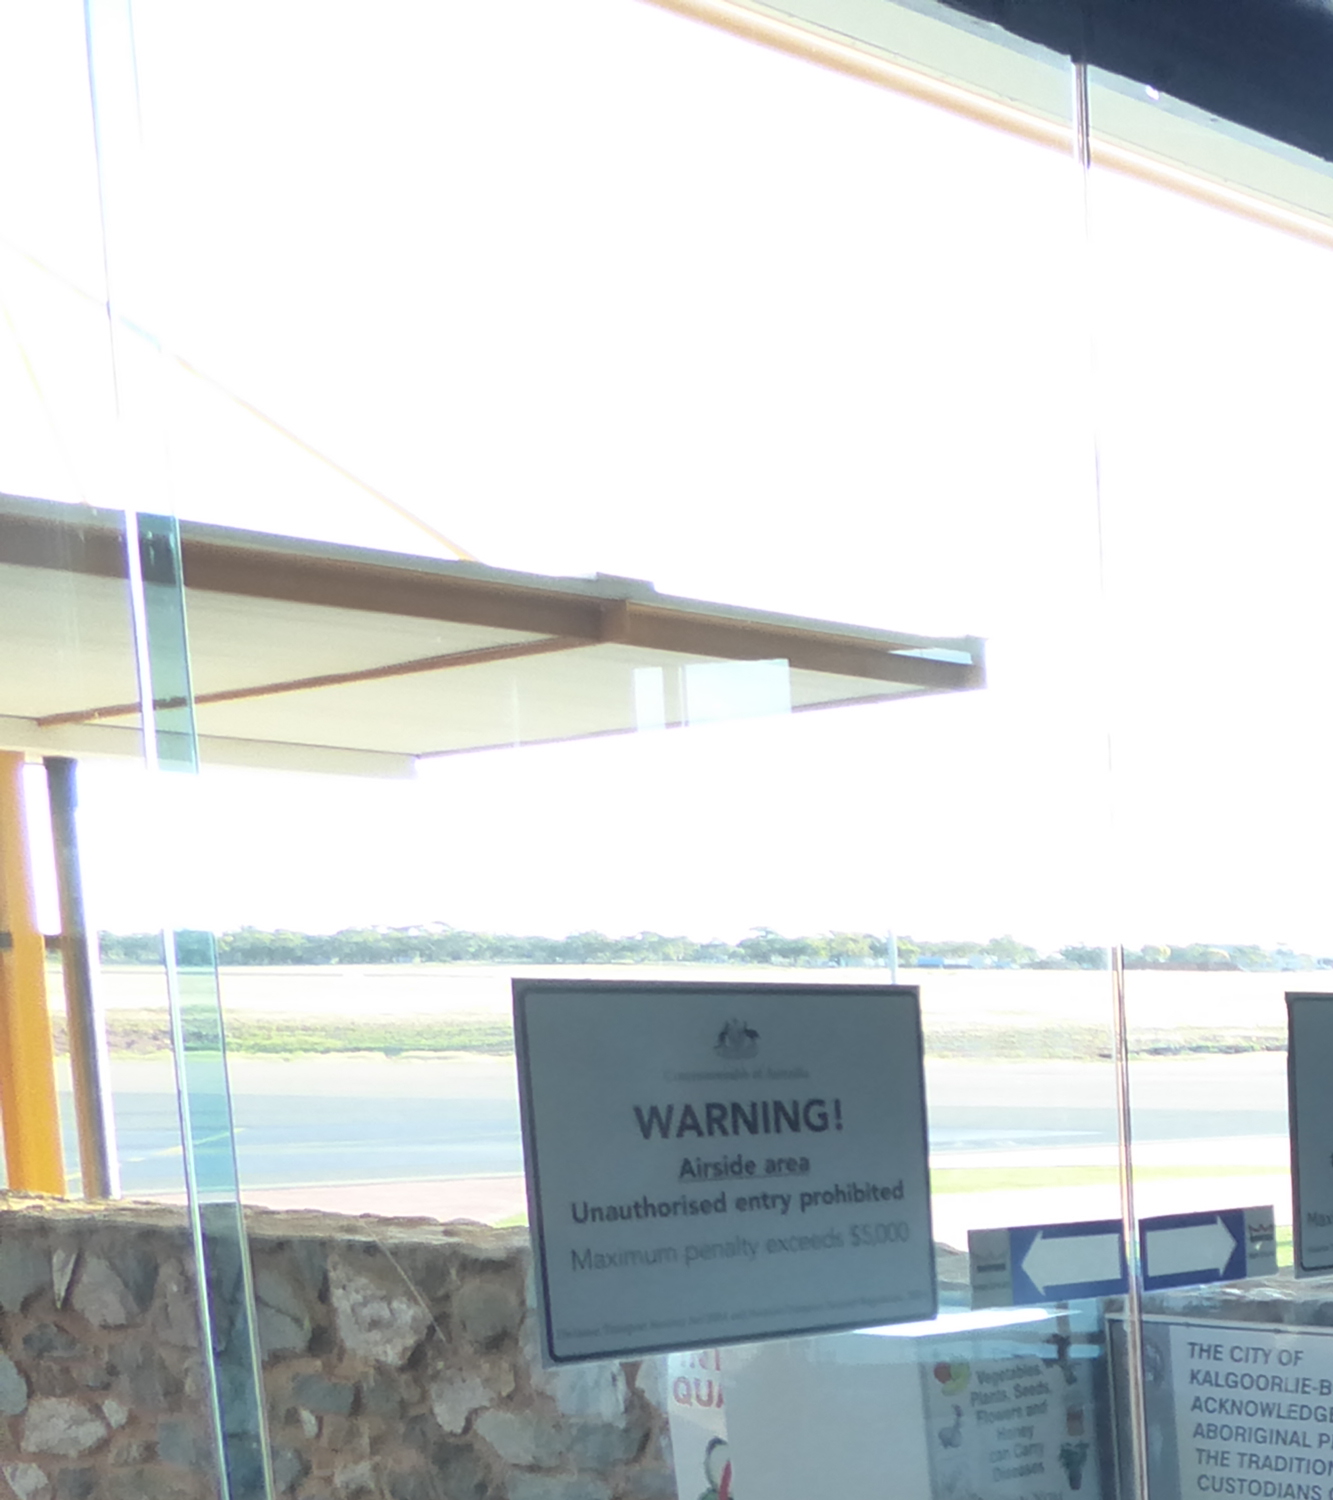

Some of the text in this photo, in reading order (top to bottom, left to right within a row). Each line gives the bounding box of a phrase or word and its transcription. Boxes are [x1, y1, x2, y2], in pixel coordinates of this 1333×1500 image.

[634, 1098, 844, 1140] WARNING!
[678, 1154, 811, 1180] Airside area
[571, 1179, 905, 1224] Unauthorised entry prohibited
[570, 1221, 910, 1272] Maximum penalty exceeds $5,000
[1187, 1341, 1305, 1367] THE CITY OF
[976, 1400, 1047, 1425] Flowers and
[997, 1423, 1034, 1442] Honey
[1192, 1423, 1312, 1448] ABORIGINAL
[1013, 1441, 1045, 1461] Carry
[1195, 1448, 1233, 1468] THE
